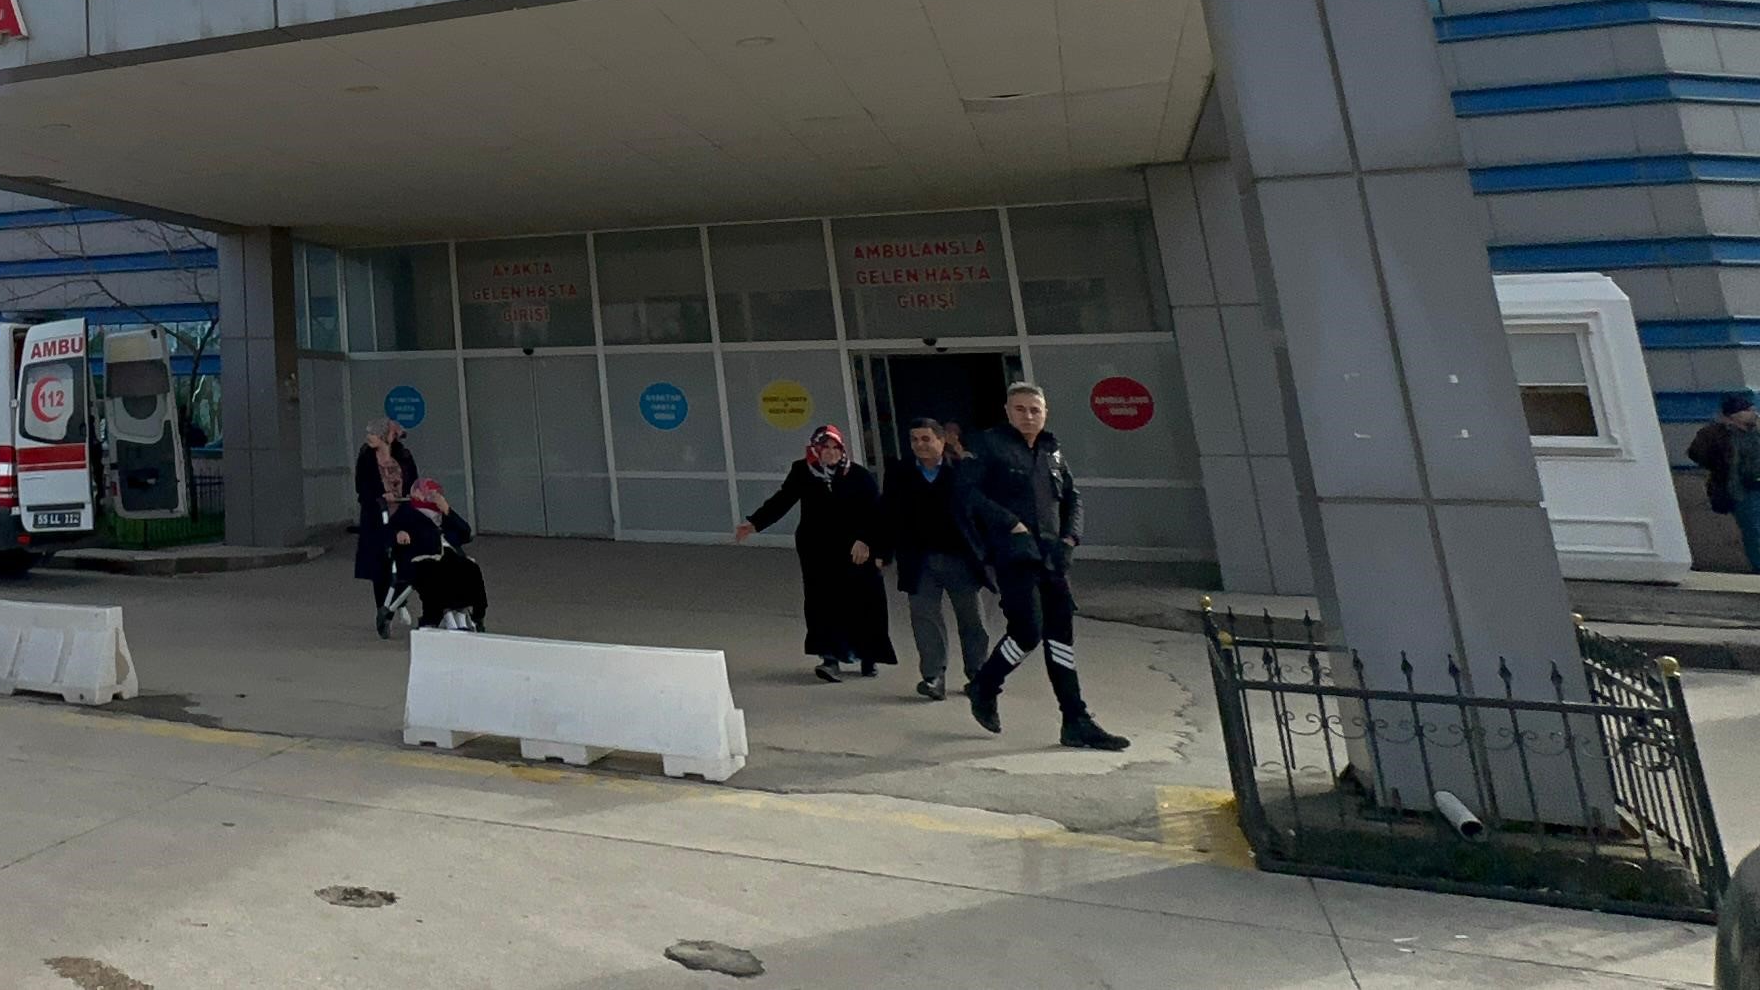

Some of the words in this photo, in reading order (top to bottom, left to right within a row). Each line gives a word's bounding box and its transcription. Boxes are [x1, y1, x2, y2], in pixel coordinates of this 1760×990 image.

[854, 239, 986, 259] AMBULANSLA
[493, 262, 553, 277] AYAKTA
[856, 268, 919, 284] GELEN
[925, 266, 990, 282] HASTA
[472, 287, 521, 300] GELEN
[526, 284, 577, 298] HASTA
[31, 337, 83, 359] AMBU
[40, 390, 64, 408] 112
